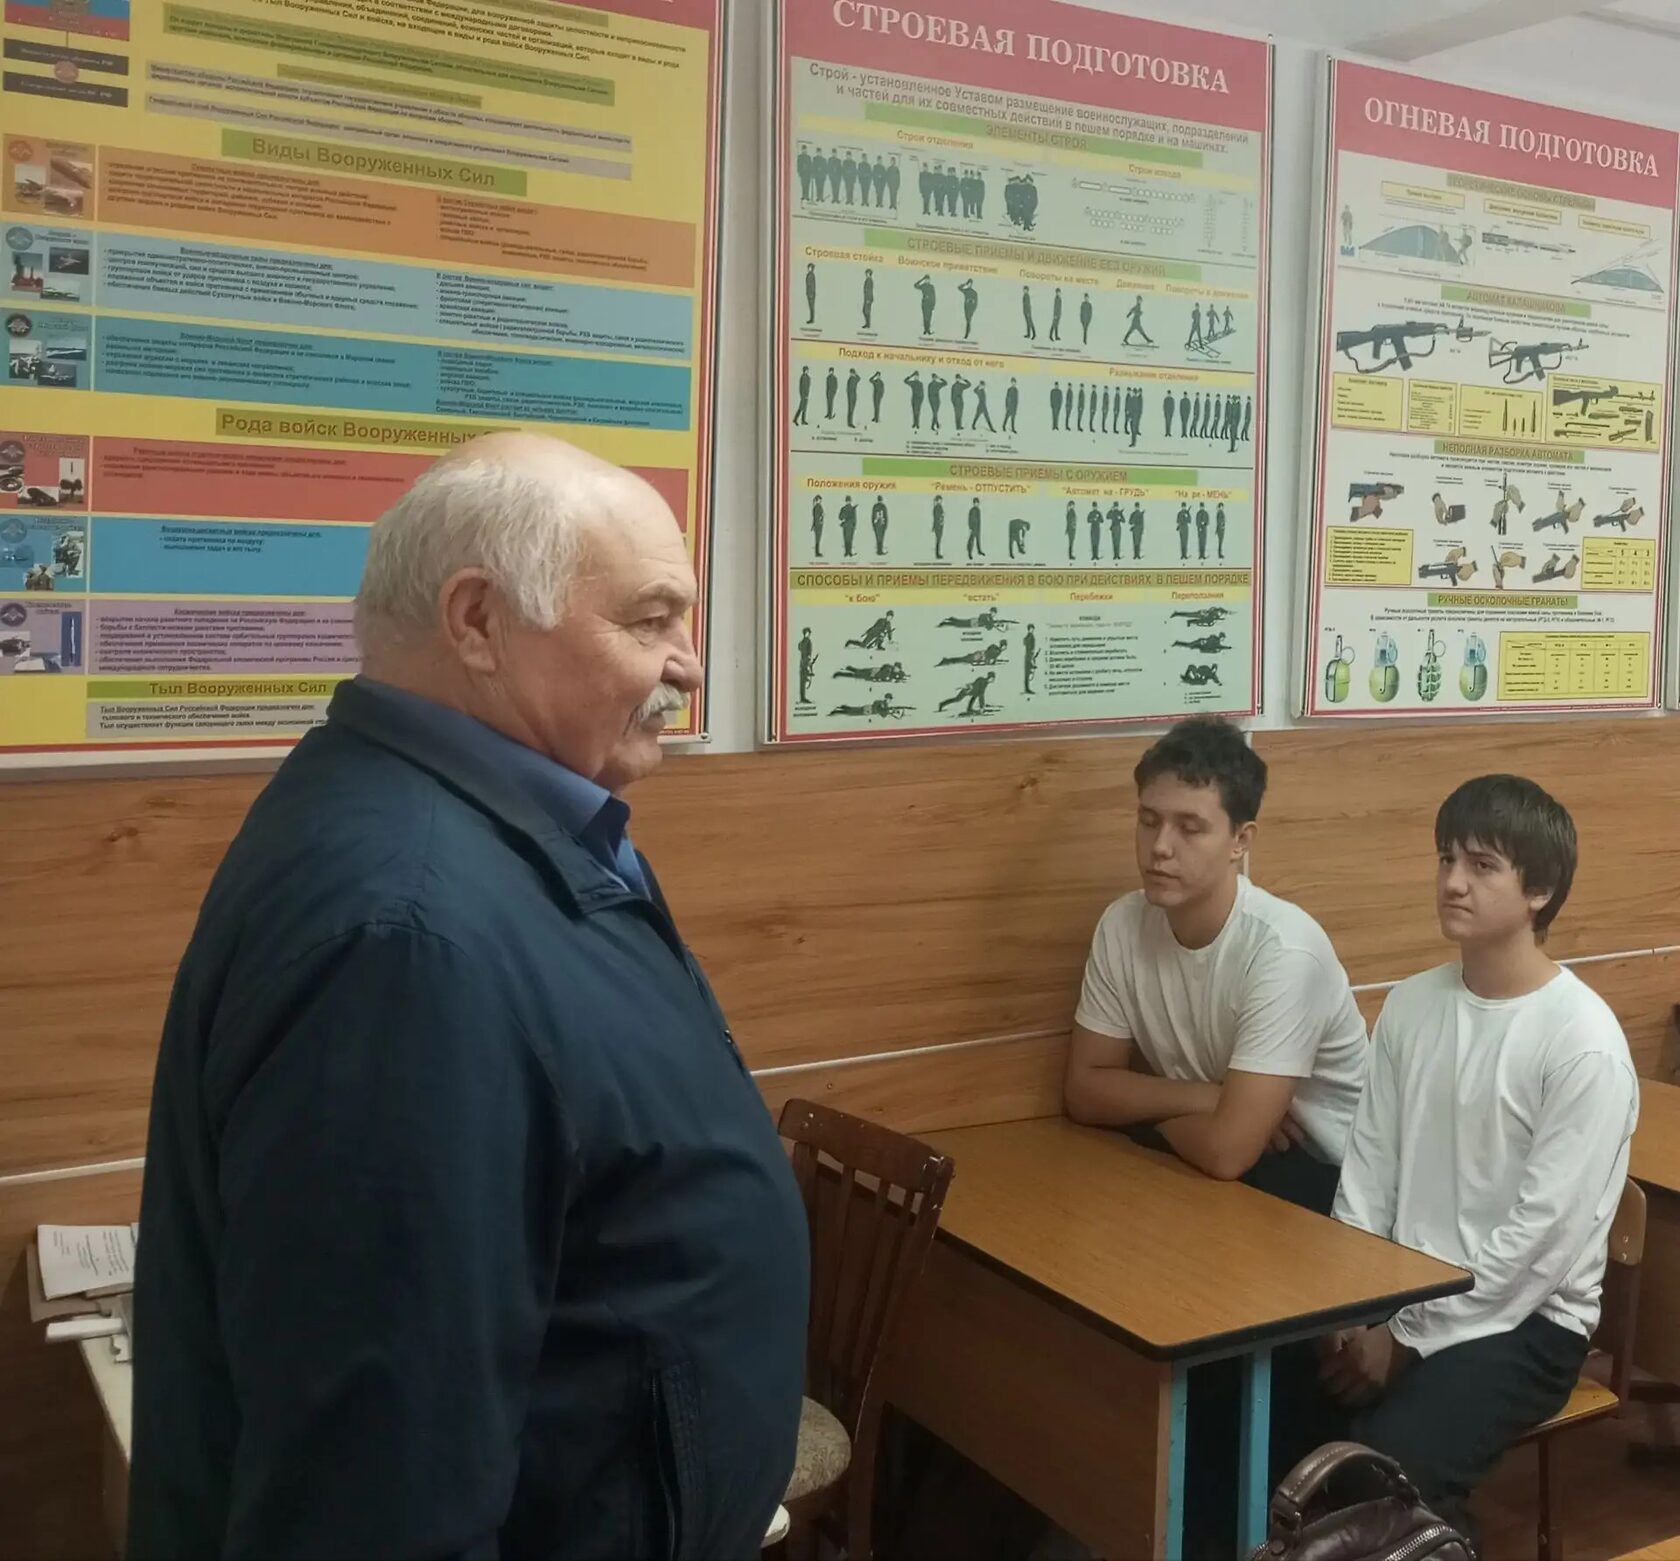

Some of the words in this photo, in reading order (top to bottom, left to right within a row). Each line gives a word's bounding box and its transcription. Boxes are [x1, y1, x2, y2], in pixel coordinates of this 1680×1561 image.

[832, 0, 1015, 56] СТРОЕВАЯ
[1027, 33, 1230, 93] ПОДГОТОВКА
[810, 63, 849, 80] Строй
[859, 73, 951, 97] установленное
[955, 86, 1003, 105] Уставом
[1007, 97, 1074, 116] размещение
[837, 84, 844, 95] и
[848, 86, 889, 101] частей
[892, 94, 915, 105] для
[918, 97, 933, 108] их
[936, 100, 1008, 120] совместных
[1065, 121, 1072, 131] в
[1075, 122, 1111, 137] пешем
[1113, 127, 1155, 145] порядке
[1158, 134, 1165, 144] и
[1167, 136, 1179, 147] на
[986, 123, 1048, 144] ЭЛЕМЕНТЫ
[1051, 134, 1088, 151] СТРОЯ
[1364, 97, 1490, 145] ОГНЕВАЯ
[1500, 124, 1659, 177] ПОДГОТОВКА
[252, 137, 309, 160] Виды
[316, 146, 452, 181] Вооруженных
[458, 166, 495, 187] Сил
[805, 246, 851, 261] Строевая
[906, 236, 972, 256] СТРОЕВЫЕ
[974, 244, 1024, 263] ПРИЕМЫ
[898, 255, 941, 270] Воинское
[838, 347, 875, 361] Подход
[883, 352, 937, 366] начальнику
[945, 357, 972, 368] отход
[973, 359, 984, 367] от
[221, 413, 273, 434] Рода
[279, 418, 337, 437] войск
[950, 464, 1013, 478] СТРОЕВЫЕ
[1015, 466, 1062, 480] ПРИЕМЫ
[1065, 469, 1074, 480] С
[1076, 469, 1128, 482] ОРУЖИЕМ
[807, 477, 860, 489] Положения
[862, 481, 896, 492] оружия
[797, 574, 862, 587] СПОСОБЫ
[865, 574, 874, 587] И
[876, 574, 929, 587] ПРИЕМЫ
[932, 573, 1024, 587] ПЕРЕДВИЖЕНИЯ
[1028, 573, 1035, 586] В
[1037, 573, 1065, 586] БОЮ
[1067, 573, 1088, 586] ПРИ
[1090, 572, 1151, 587] ДЕЙСТВИЯХ
[1156, 573, 1163, 585] В
[1165, 573, 1202, 585] ПЕШЕМ
[1205, 572, 1249, 586] ПОРЯДКЕ
[856, 593, 880, 603] бою"
[1437, 594, 1473, 606] РУЧНЫЕ
[1473, 594, 1530, 607] ОСКОЛОЧНЫЕ
[1530, 595, 1569, 607] ГРАНАТЫ
[150, 682, 182, 695] Тыл
[187, 682, 295, 697] Вооруженных
[298, 680, 327, 694] Сил
